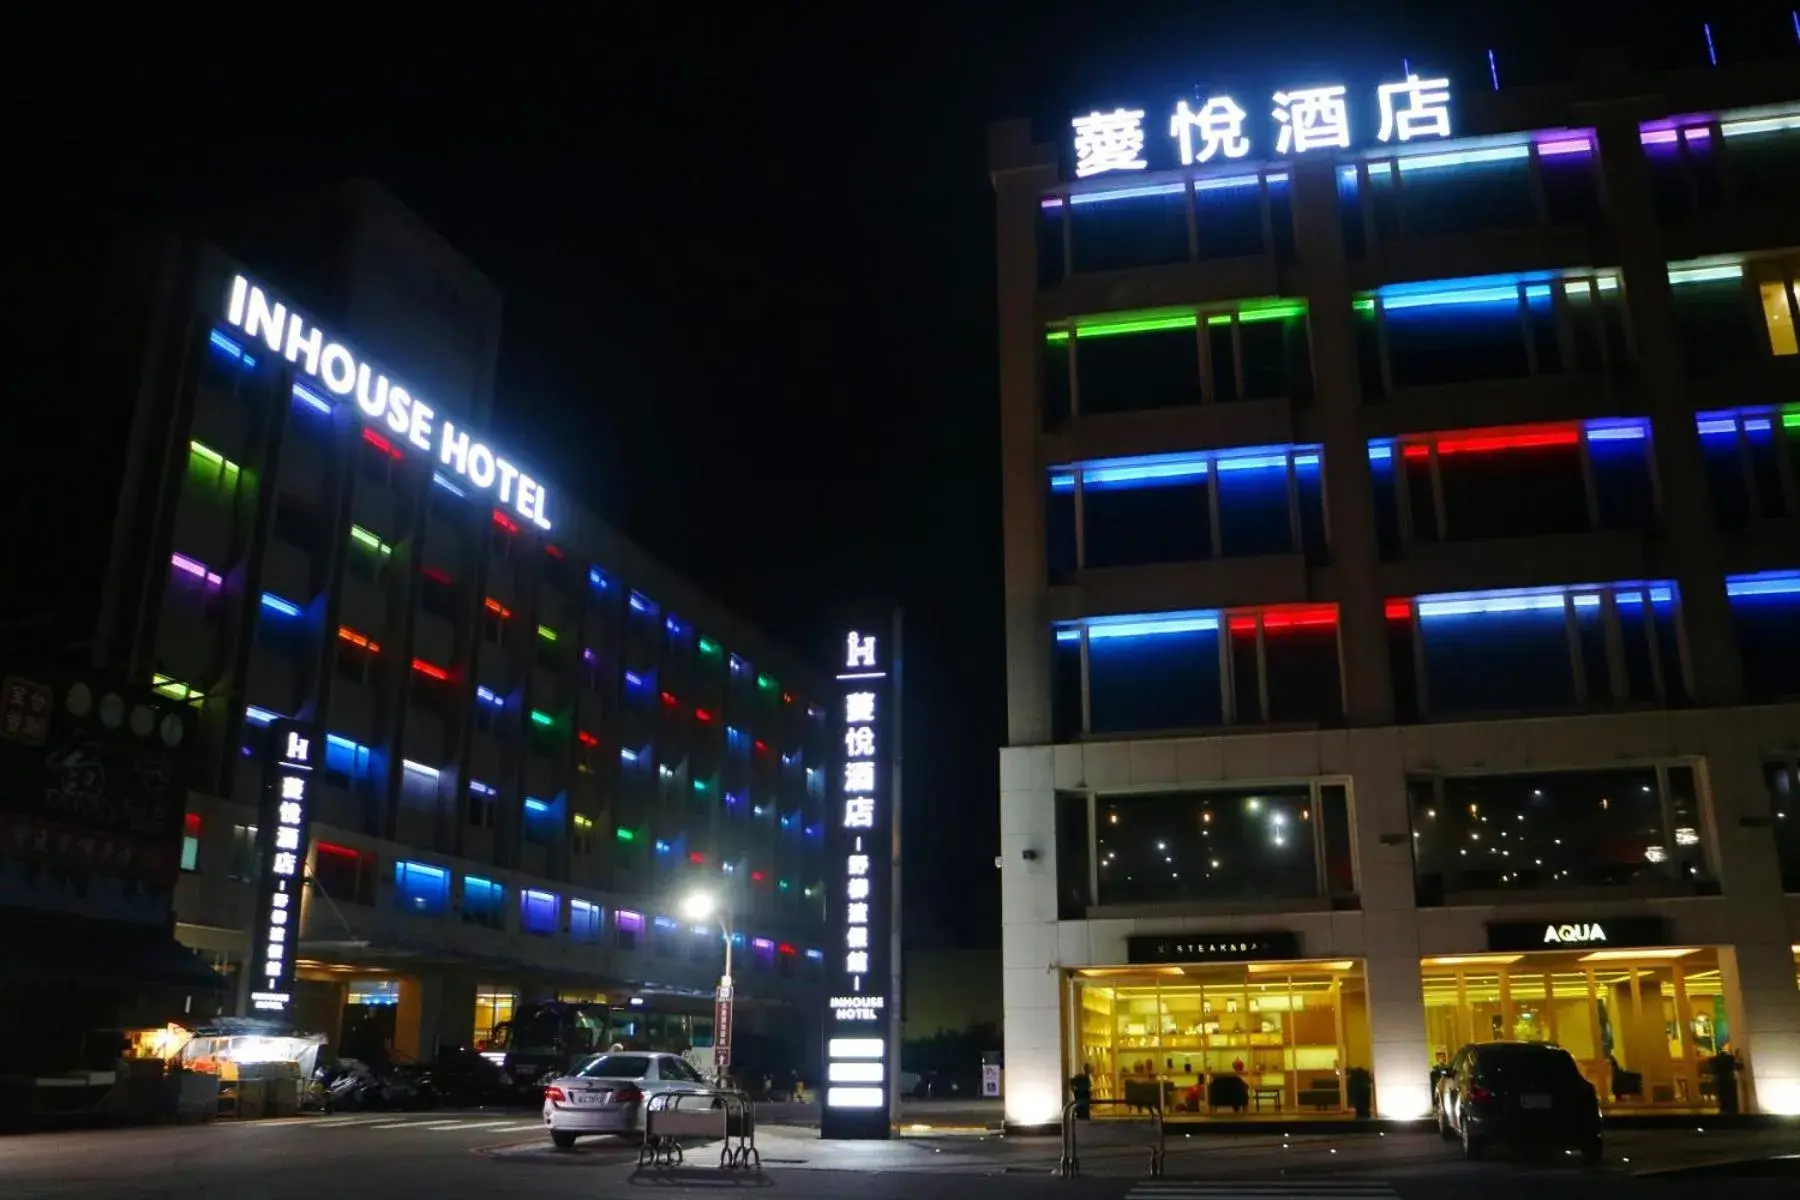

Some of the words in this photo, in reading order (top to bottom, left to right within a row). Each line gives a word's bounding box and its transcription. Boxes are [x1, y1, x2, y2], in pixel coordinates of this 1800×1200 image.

[228, 275, 434, 450] INHOUSE
[440, 421, 551, 529] HOTEL
[1544, 924, 1607, 943] AQUA
[830, 997, 884, 1008] INHOUSE
[836, 1009, 877, 1020] HOTEL
